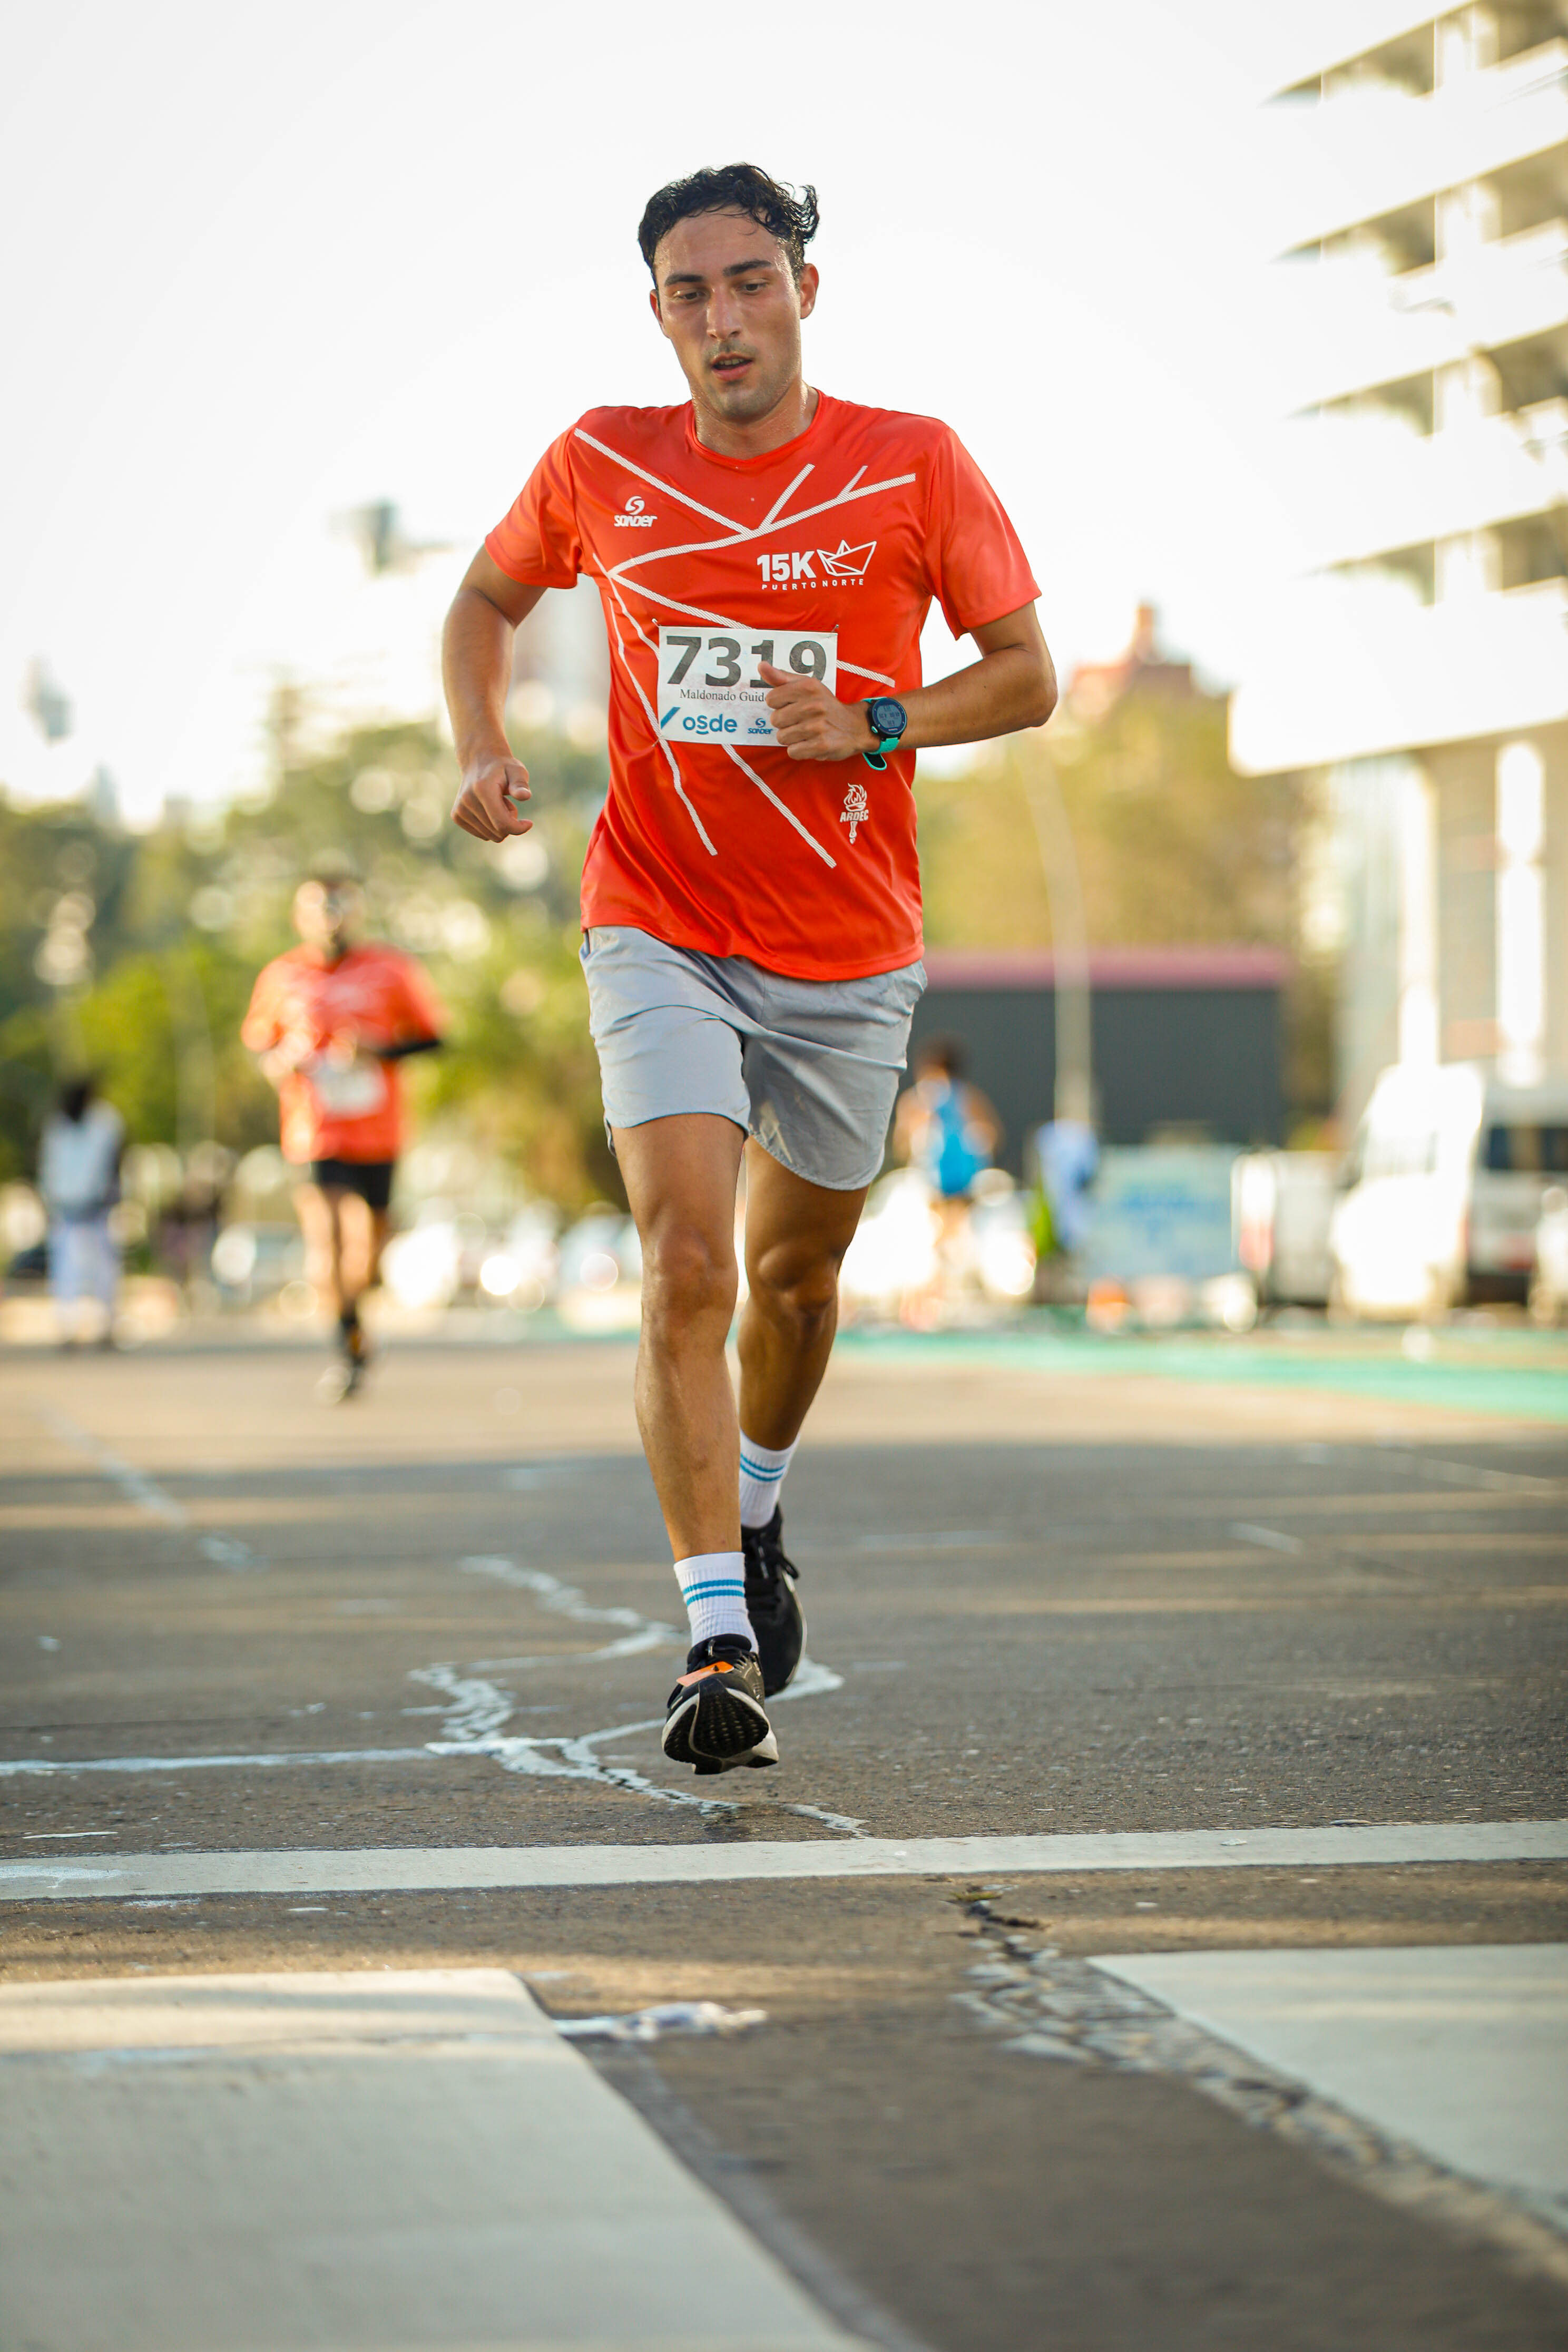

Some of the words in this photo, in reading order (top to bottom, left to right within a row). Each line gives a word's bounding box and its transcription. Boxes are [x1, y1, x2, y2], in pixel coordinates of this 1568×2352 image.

[757, 551, 817, 582] 15K
[761, 581, 817, 591] PUERTO
[822, 578, 864, 587] NORTE
[666, 635, 827, 689] 7319
[680, 689, 736, 702] Maldonado
[739, 691, 767, 702] Guid
[683, 713, 738, 734] osde
[839, 809, 869, 822] ARDEC
